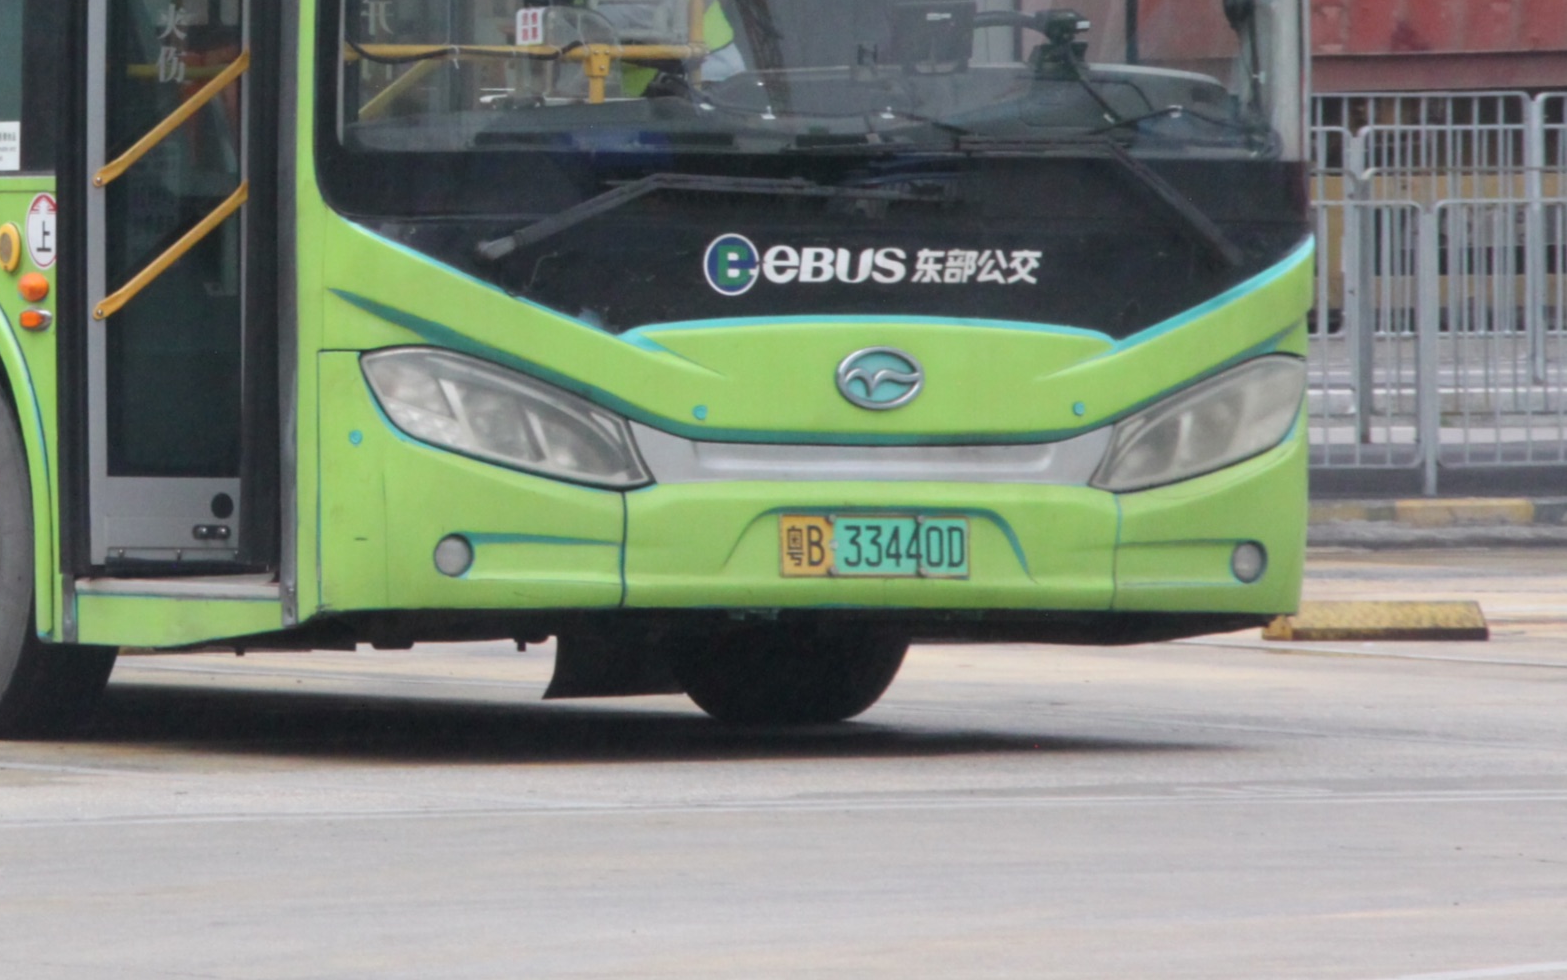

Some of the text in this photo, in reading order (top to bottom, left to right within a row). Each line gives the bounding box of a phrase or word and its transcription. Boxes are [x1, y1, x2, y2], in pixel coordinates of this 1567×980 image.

[36, 221, 52, 253] 上
[911, 248, 1043, 284] 东部公交
